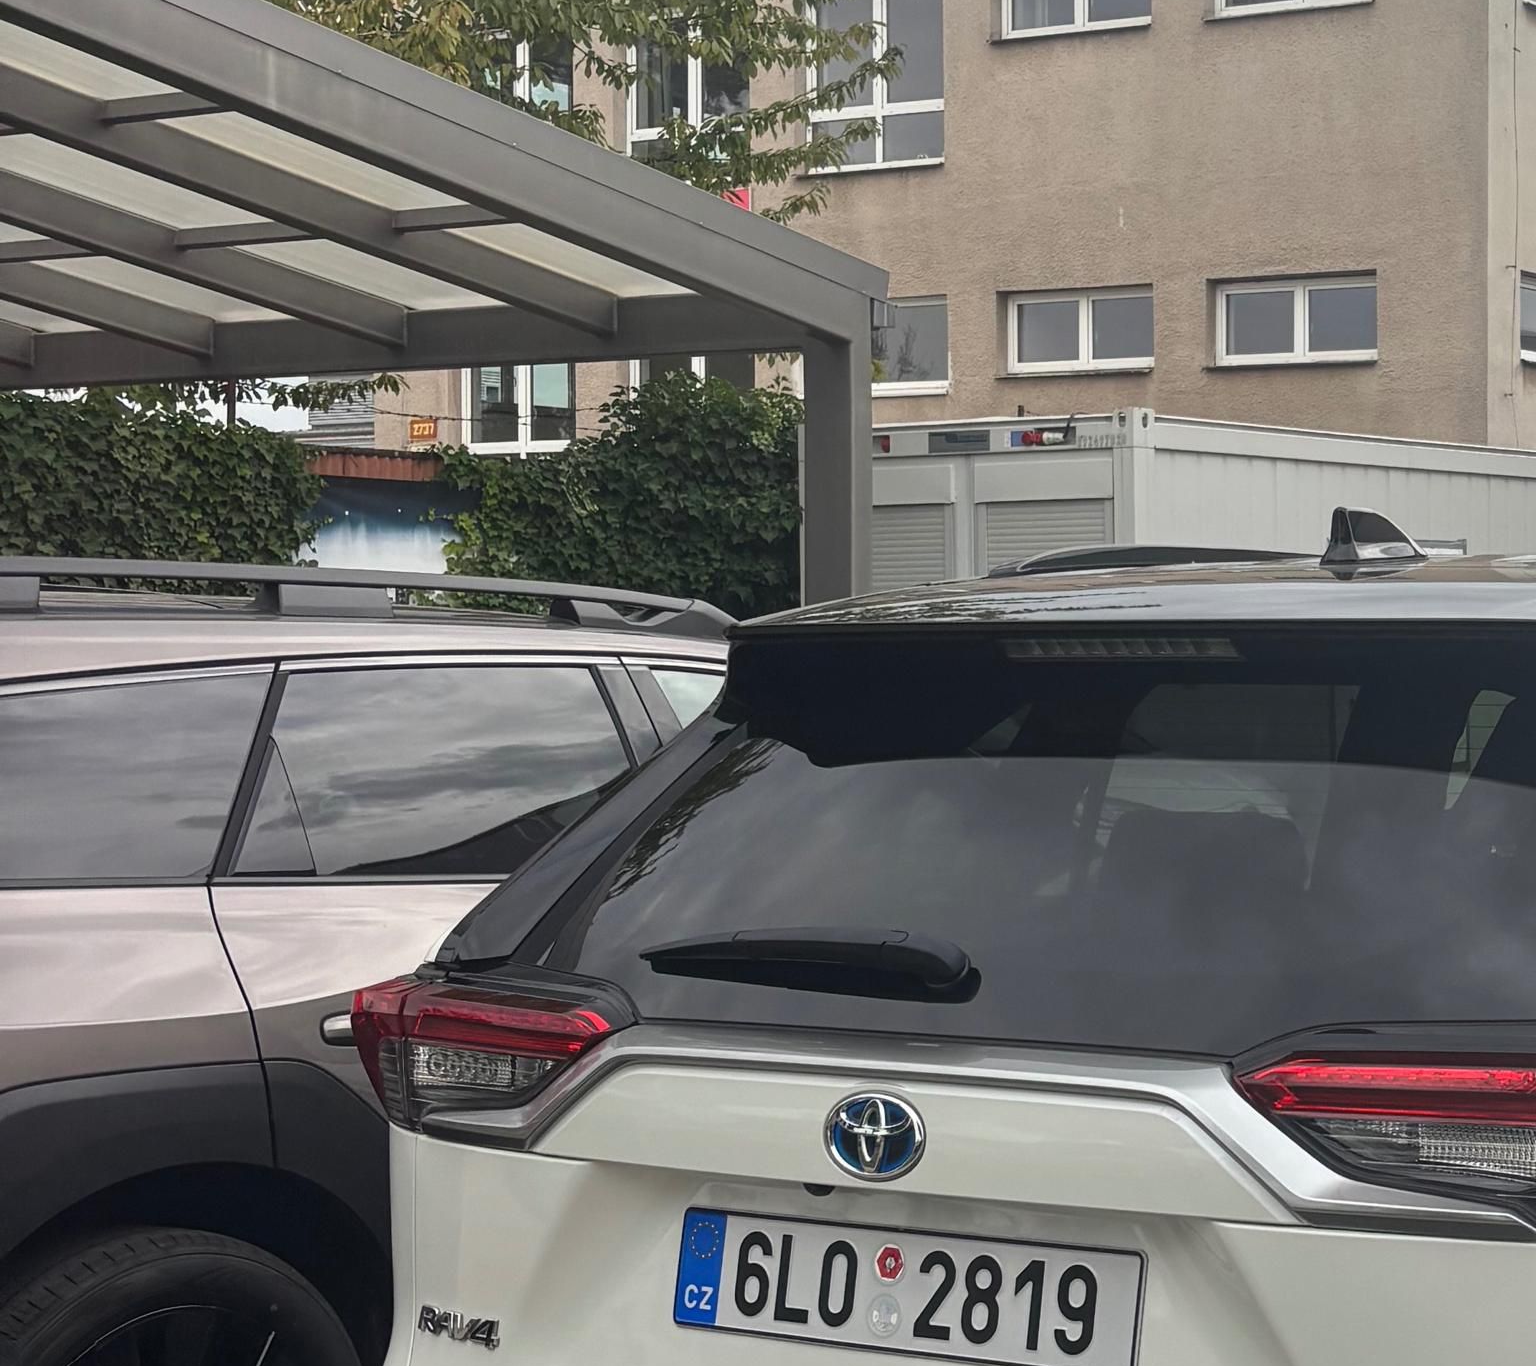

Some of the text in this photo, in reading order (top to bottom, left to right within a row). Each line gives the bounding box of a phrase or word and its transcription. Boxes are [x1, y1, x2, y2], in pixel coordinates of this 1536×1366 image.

[683, 1283, 714, 1311] CZ
[733, 1230, 1099, 1356] 6L0 2819
[417, 1305, 501, 1351] RAV4
